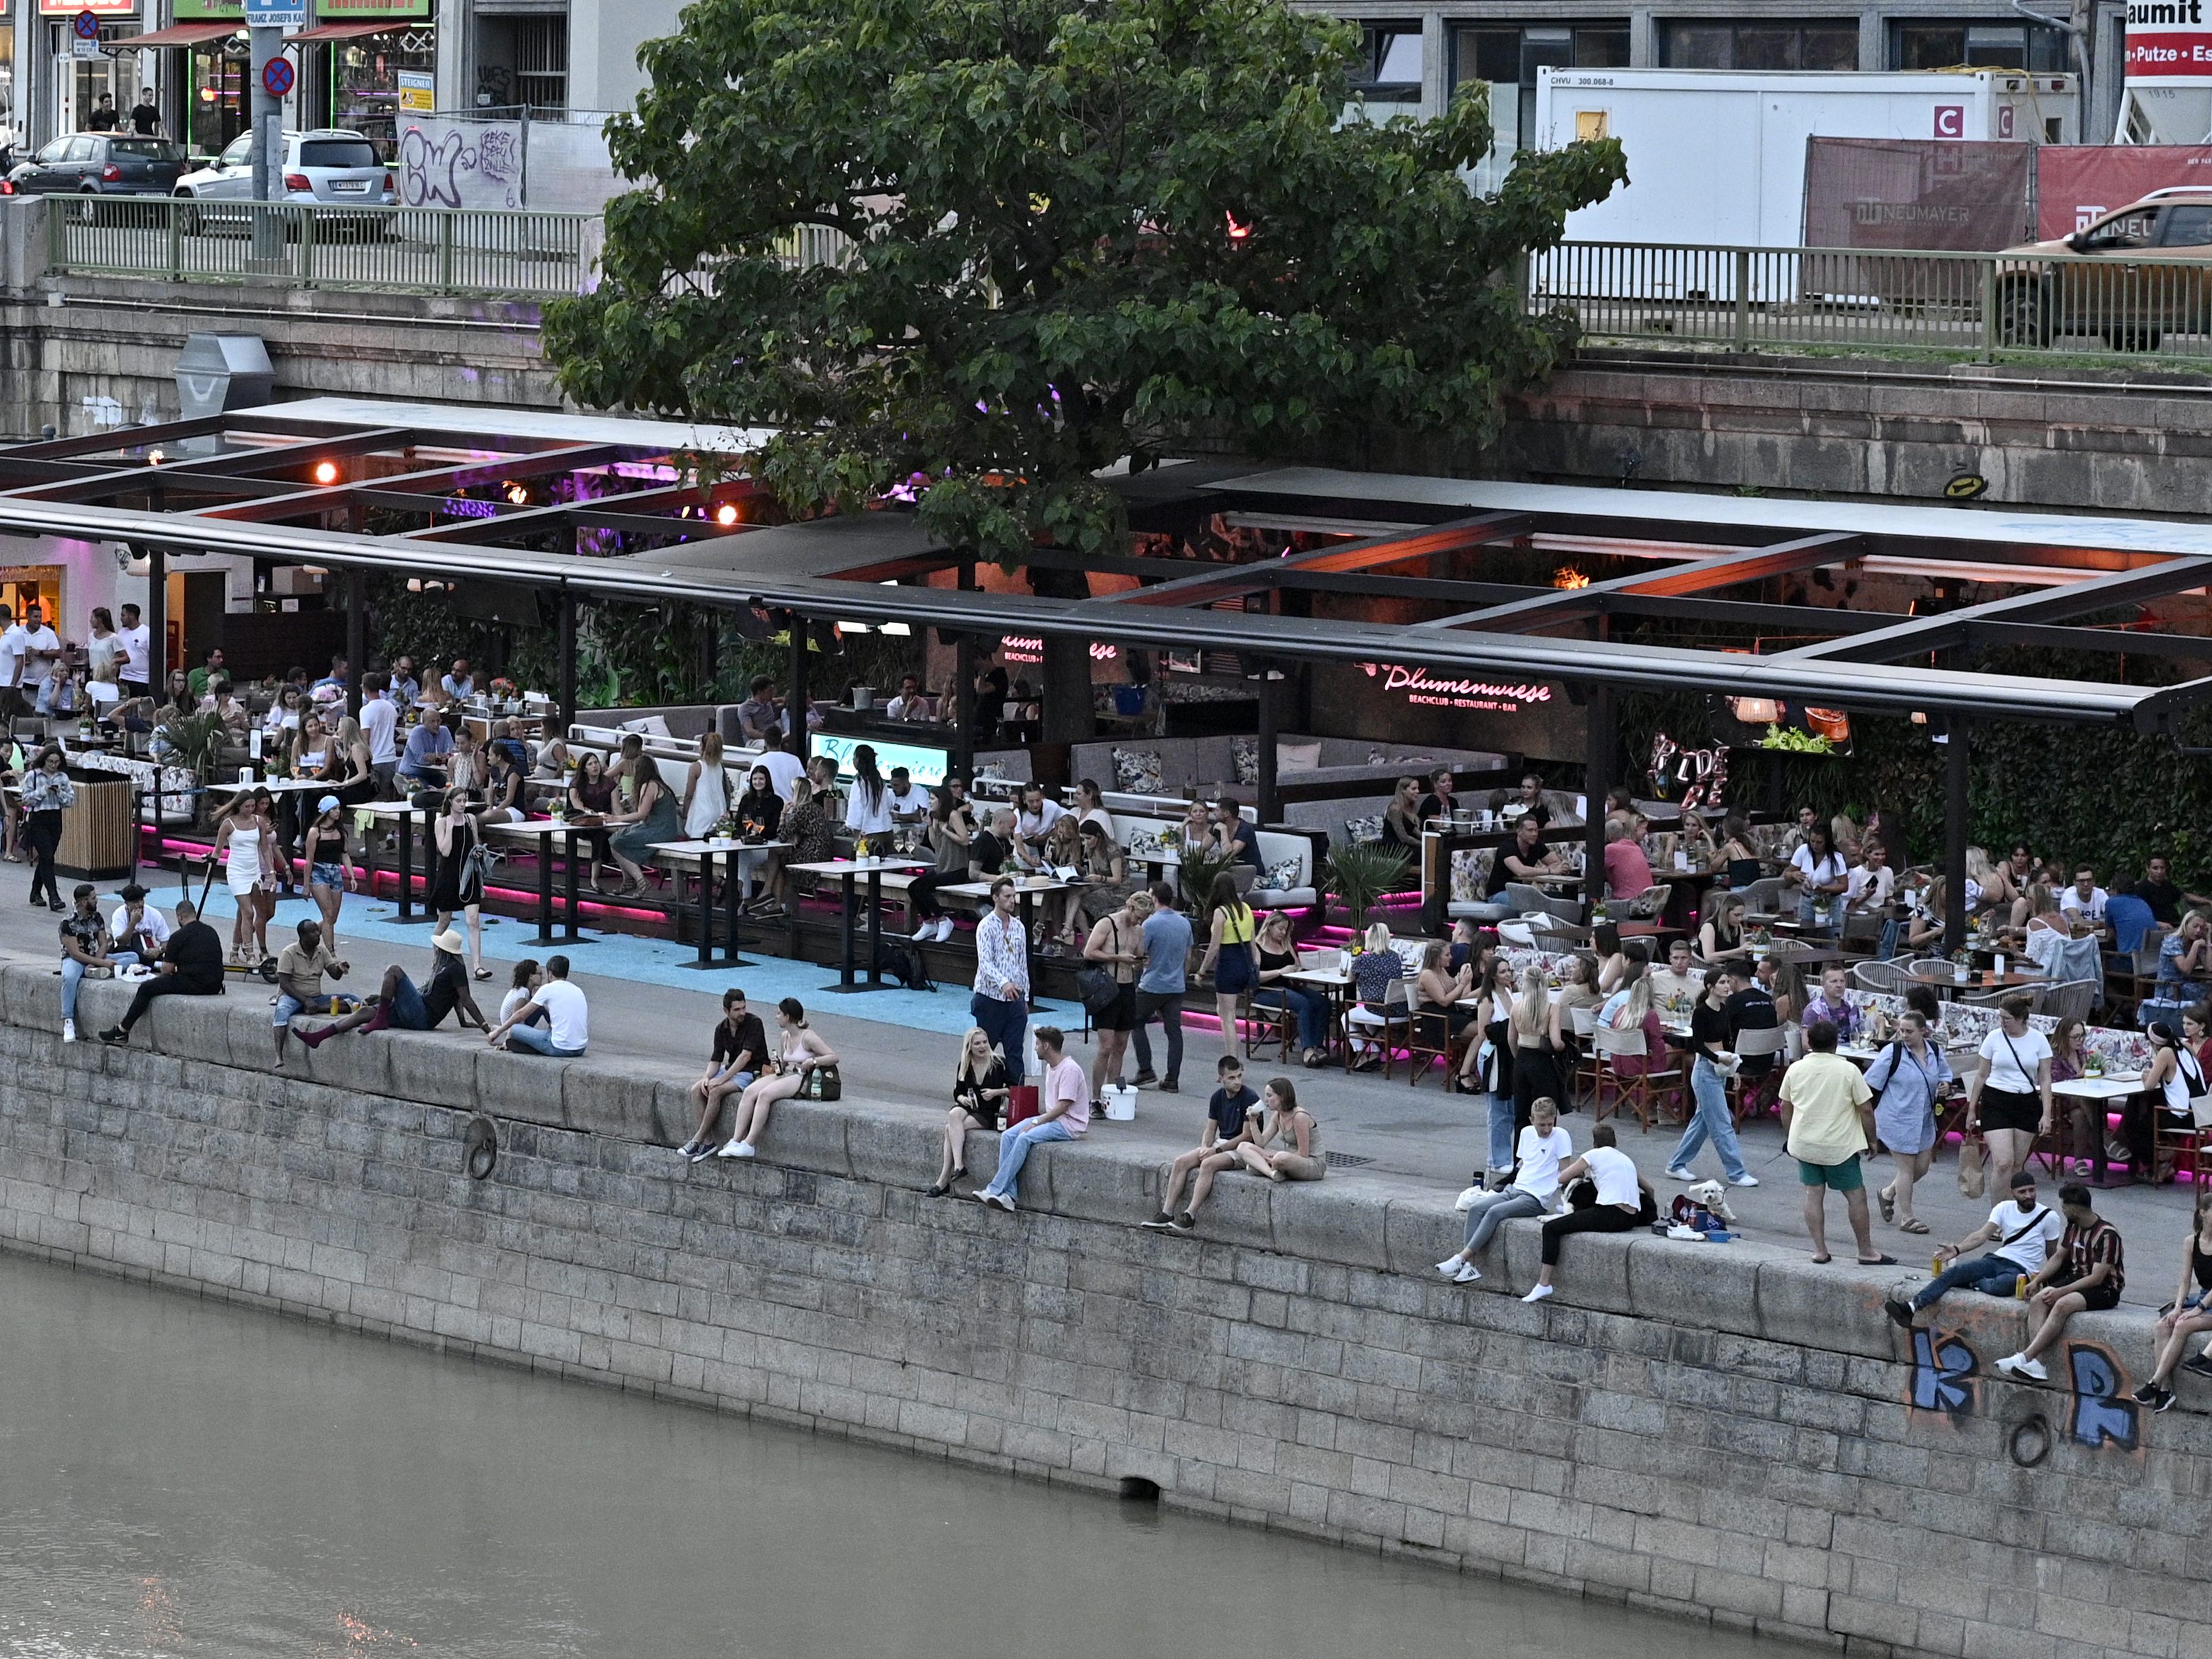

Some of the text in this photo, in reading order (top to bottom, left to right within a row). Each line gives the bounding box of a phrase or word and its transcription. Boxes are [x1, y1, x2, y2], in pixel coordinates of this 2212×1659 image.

[247, 13, 268, 23] FRANZ
[268, 13, 292, 23] JOSEFS
[2125, 0, 2202, 24] aumit
[2137, 46, 2178, 62] Putze
[401, 77, 431, 89] STEIGNER
[1883, 205, 1969, 222] NEUMAYER
[1004, 651, 1037, 663] BEACHCLUB
[1409, 694, 1517, 713] BEACHCLUB RESTAURANT BAR
